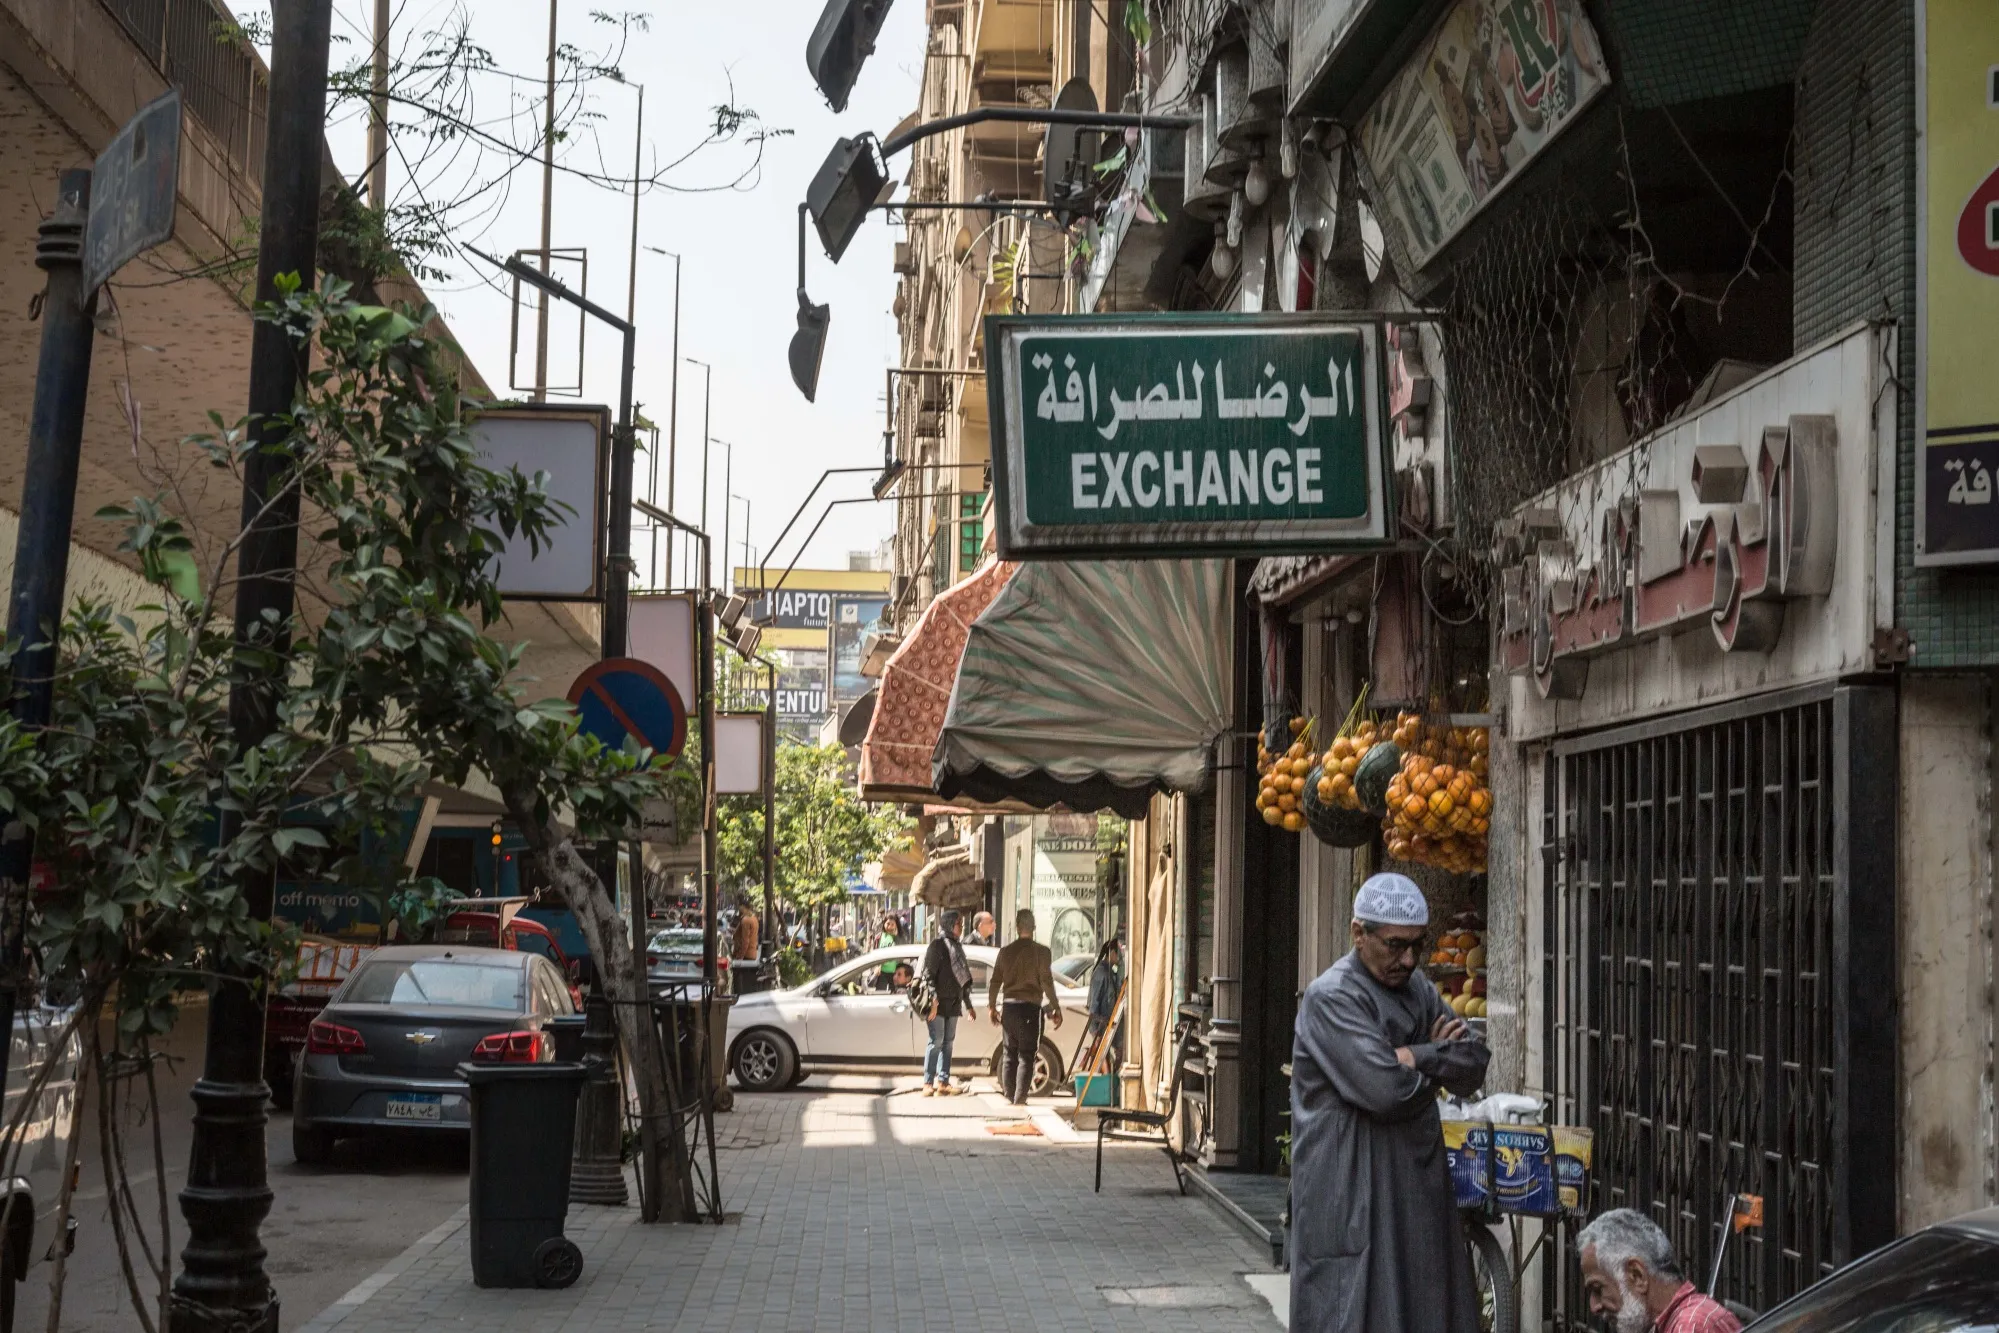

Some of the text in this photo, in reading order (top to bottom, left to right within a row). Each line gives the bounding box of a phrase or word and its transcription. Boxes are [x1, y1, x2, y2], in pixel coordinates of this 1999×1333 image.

[1031, 351, 1206, 441] للصرافة
[1214, 354, 1355, 437] الرضا
[1070, 447, 1325, 510] EXCHANGE
[1473, 1130, 1545, 1150] SABROSAR
